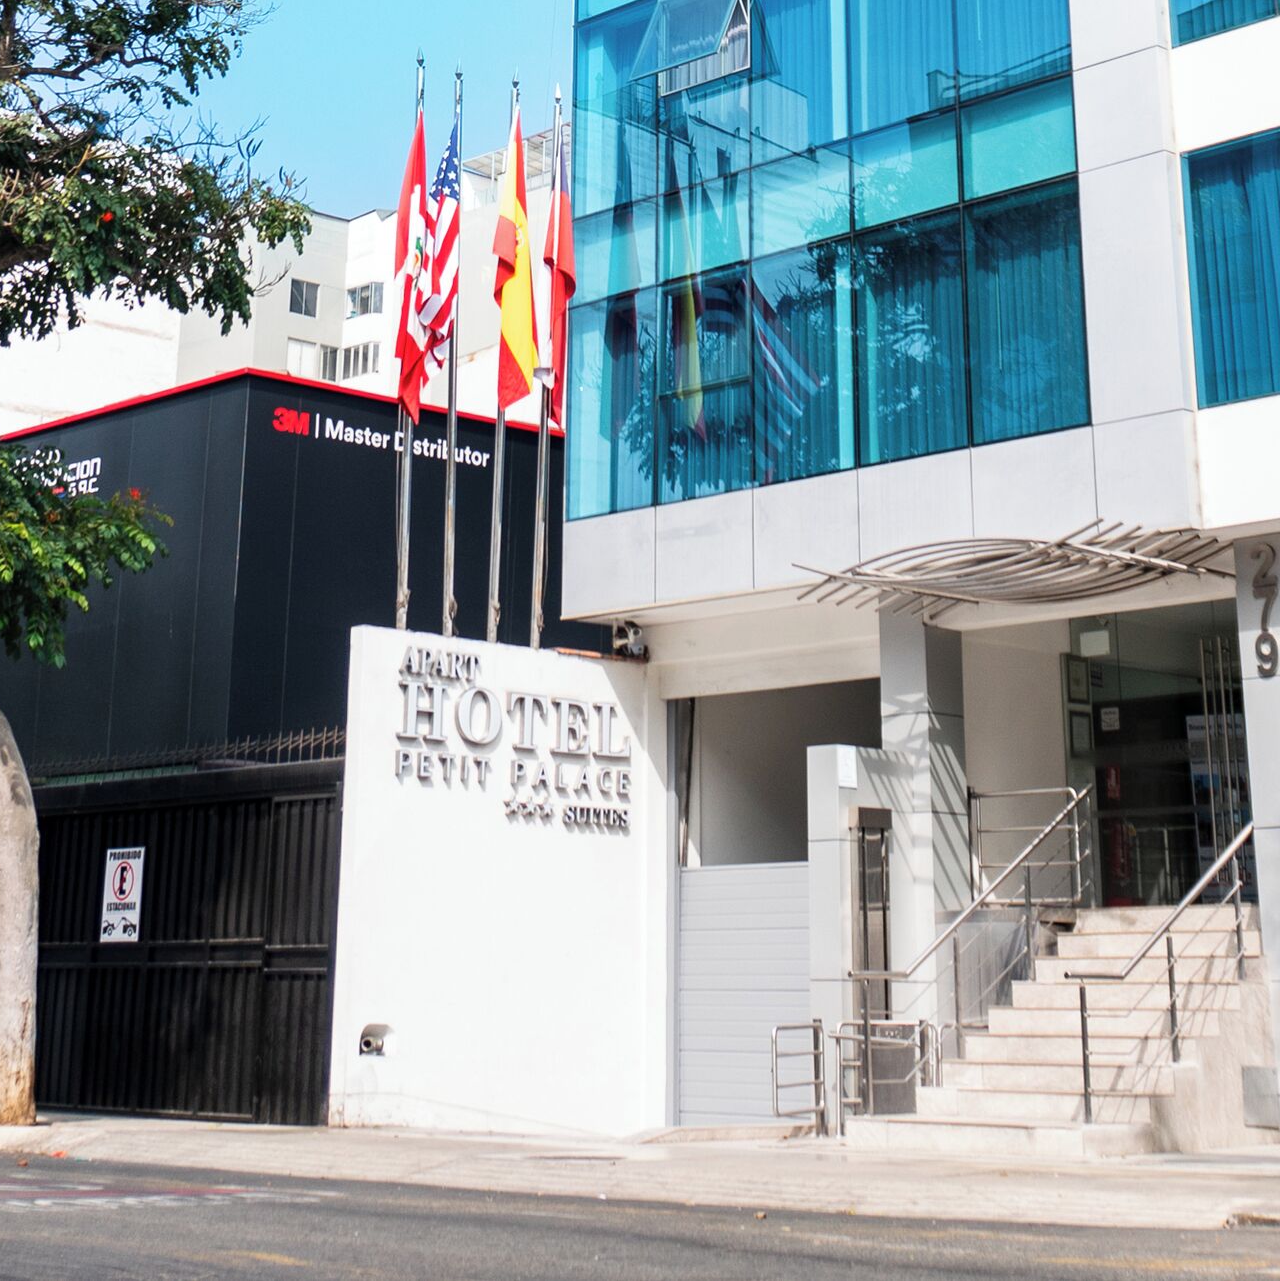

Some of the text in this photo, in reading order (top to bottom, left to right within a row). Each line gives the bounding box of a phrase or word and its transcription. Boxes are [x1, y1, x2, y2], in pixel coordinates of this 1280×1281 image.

[272, 407, 490, 468] 3M Master Dstributor
[1251, 541, 1279, 679] 279
[400, 646, 480, 681] APART
[396, 680, 631, 759] HOTEL
[396, 749, 631, 797] PETIT PALACE
[563, 806, 629, 829] SUITES
[109, 850, 141, 861] PROHIBIDO
[119, 866, 127, 896] E
[106, 902, 136, 912] ESTACIONAR
